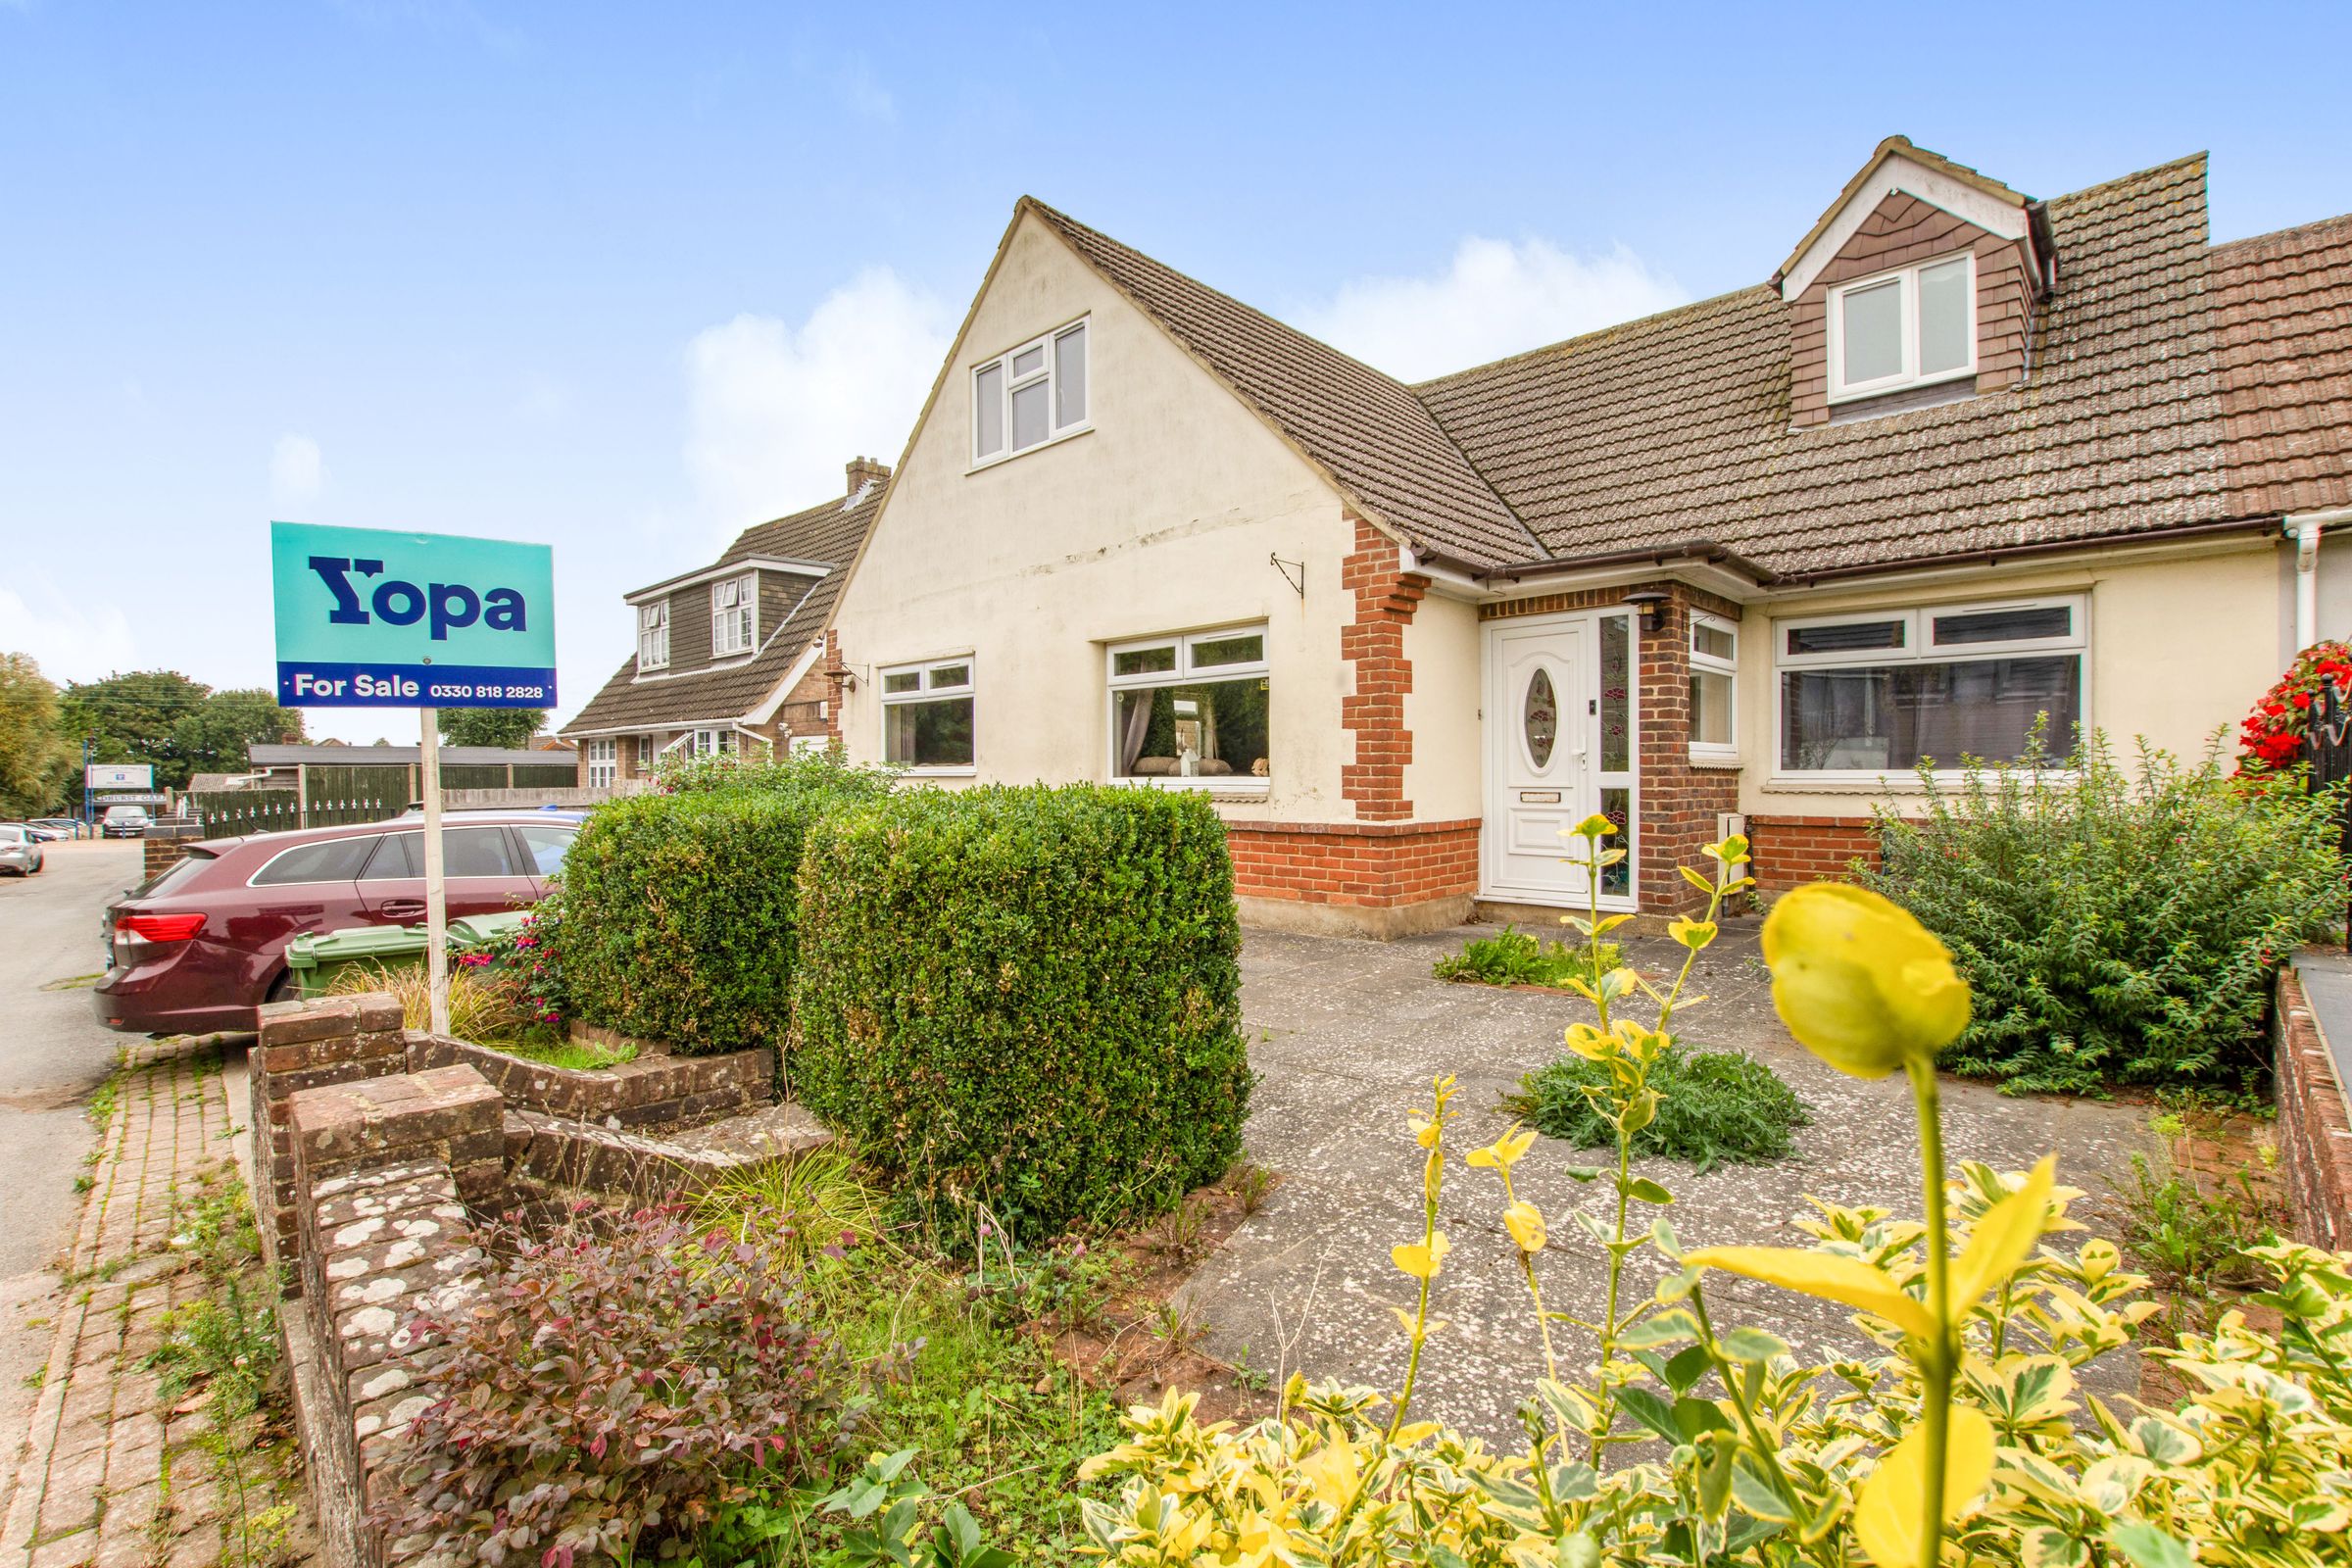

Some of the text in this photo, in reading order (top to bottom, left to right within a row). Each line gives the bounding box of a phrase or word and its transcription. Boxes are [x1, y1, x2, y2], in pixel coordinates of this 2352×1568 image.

[309, 556, 527, 641] Yopa
[295, 673, 543, 699] For Sale 0330 818 2828
